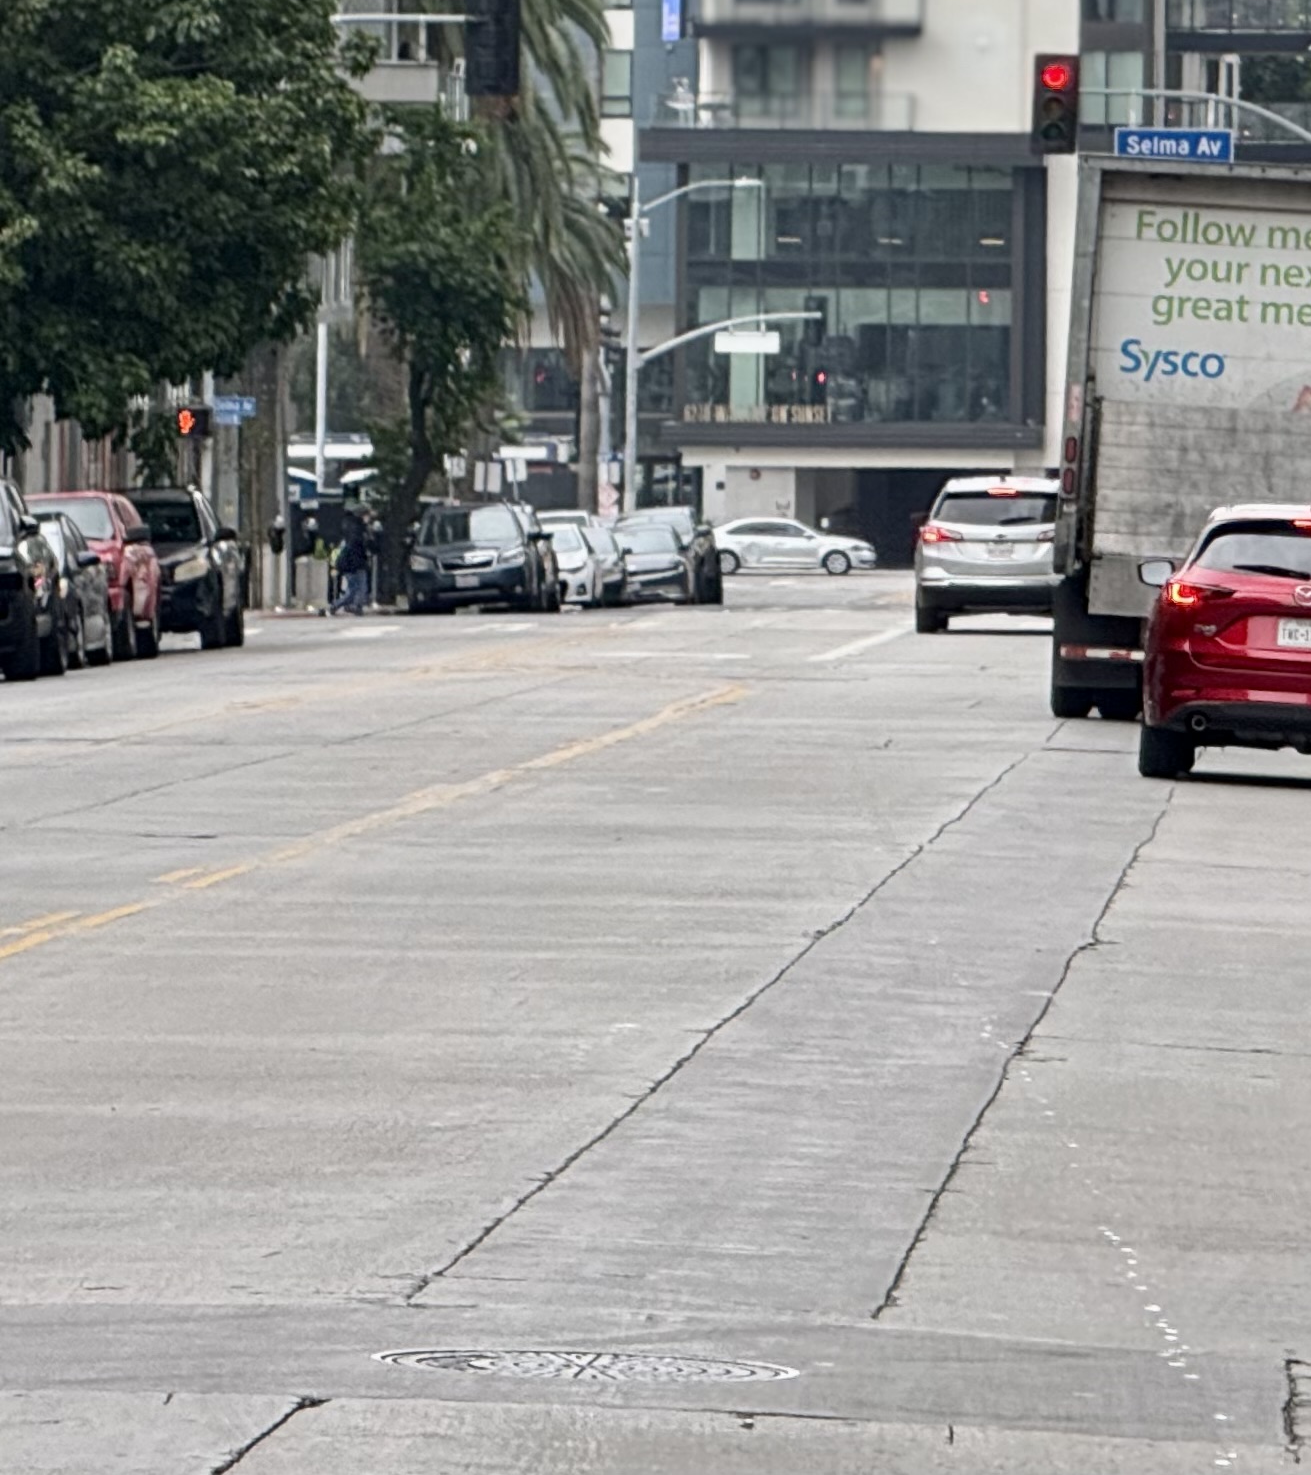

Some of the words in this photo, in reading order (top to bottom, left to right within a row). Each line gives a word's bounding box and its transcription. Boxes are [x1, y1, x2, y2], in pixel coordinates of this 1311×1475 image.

[1126, 135, 1189, 155] Selma
[1196, 137, 1221, 157] Av
[1136, 209, 1256, 247] Follow
[1164, 257, 1251, 288] your
[1151, 293, 1249, 326] great
[1119, 338, 1226, 382] Sysco
